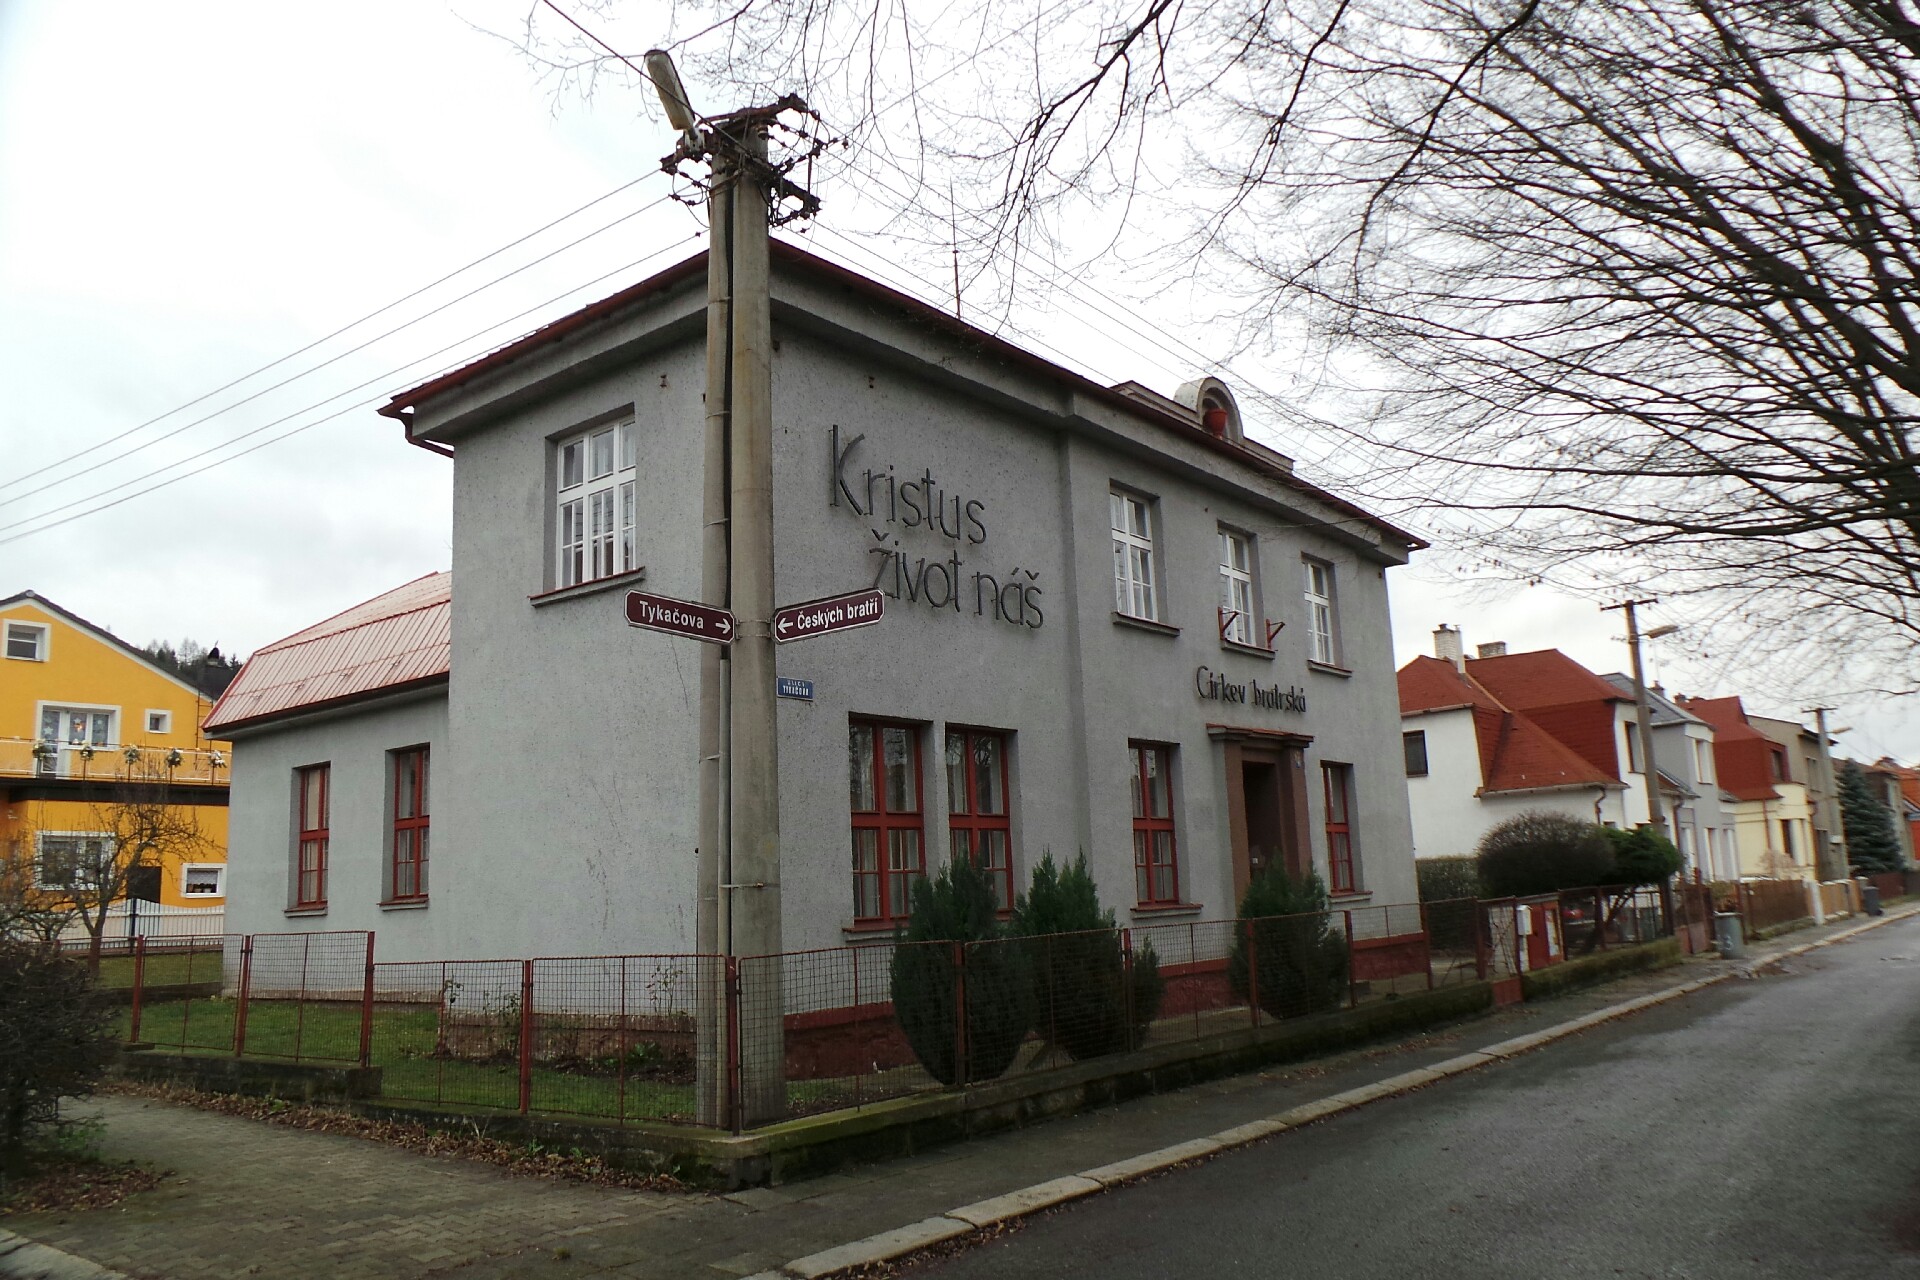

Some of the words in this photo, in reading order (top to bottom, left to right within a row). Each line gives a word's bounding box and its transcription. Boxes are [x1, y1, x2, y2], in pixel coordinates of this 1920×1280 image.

[831, 424, 987, 544] Kristus
[868, 528, 963, 613] Život
[973, 567, 1044, 629] náš
[639, 600, 704, 630] Tykačova
[797, 606, 843, 630] Českých
[847, 598, 878, 619] bratří
[1252, 679, 1306, 713] bratrská
